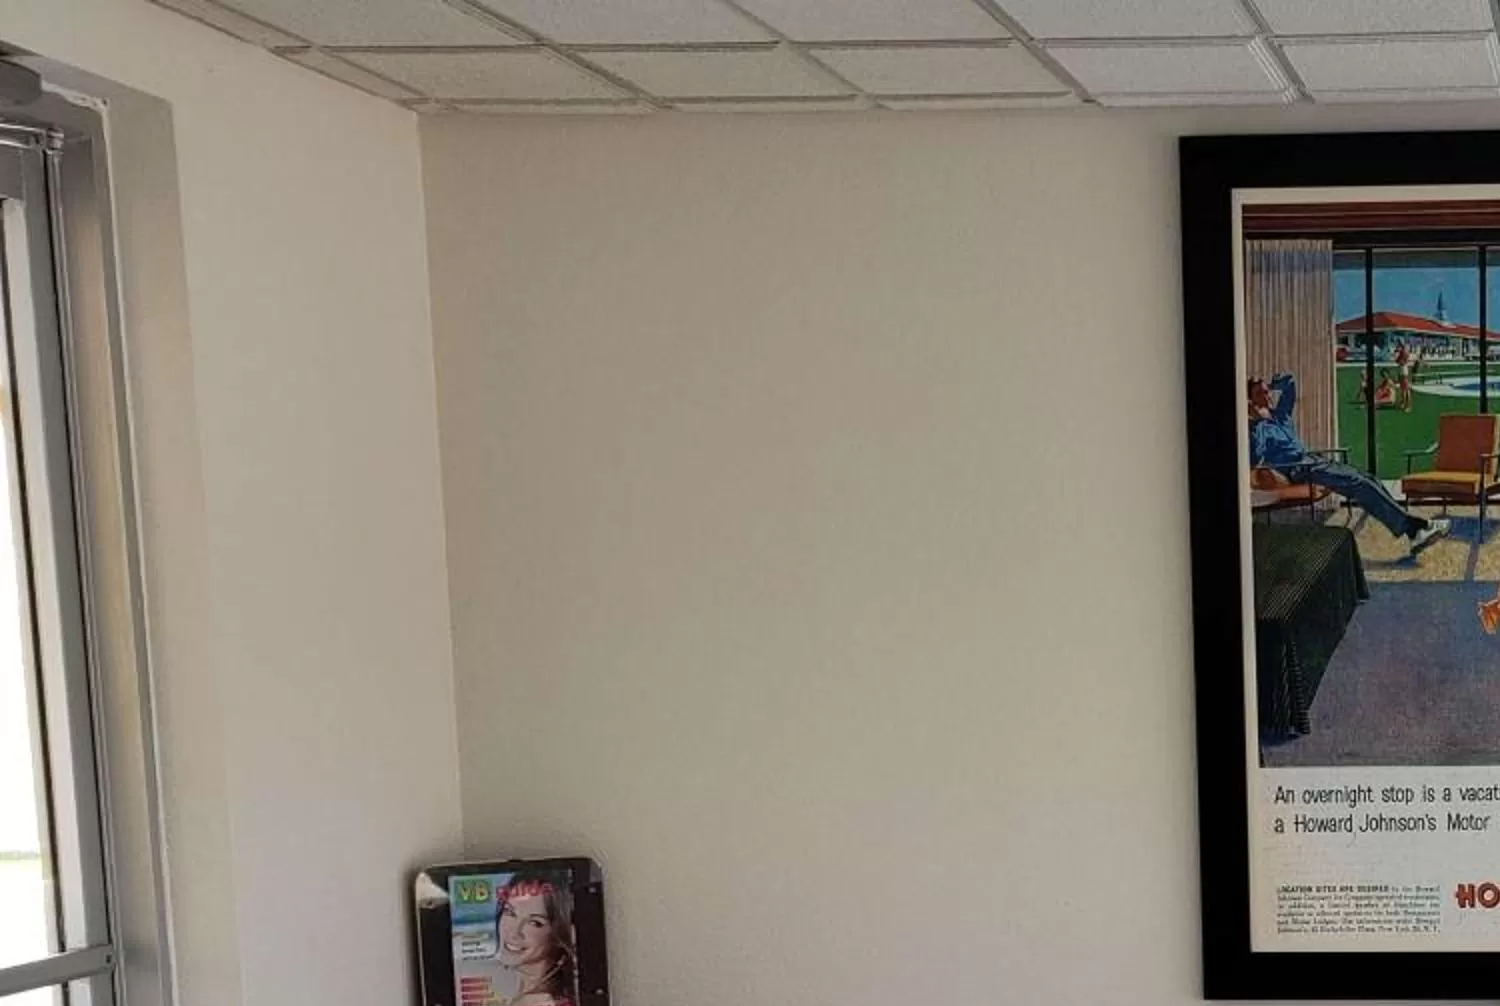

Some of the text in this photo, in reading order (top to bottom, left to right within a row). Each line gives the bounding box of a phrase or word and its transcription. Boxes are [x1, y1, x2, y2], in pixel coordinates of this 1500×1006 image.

[1274, 786, 1295, 804] An
[1301, 785, 1374, 808] overnight
[1381, 785, 1415, 805] stop
[1422, 785, 1436, 802] is
[1442, 788, 1451, 801] a
[1274, 817, 1285, 833] a
[1294, 813, 1354, 833] Howard
[1359, 813, 1437, 833] Johnson's
[1447, 813, 1491, 833] Motor
[457, 882, 490, 901] VB
